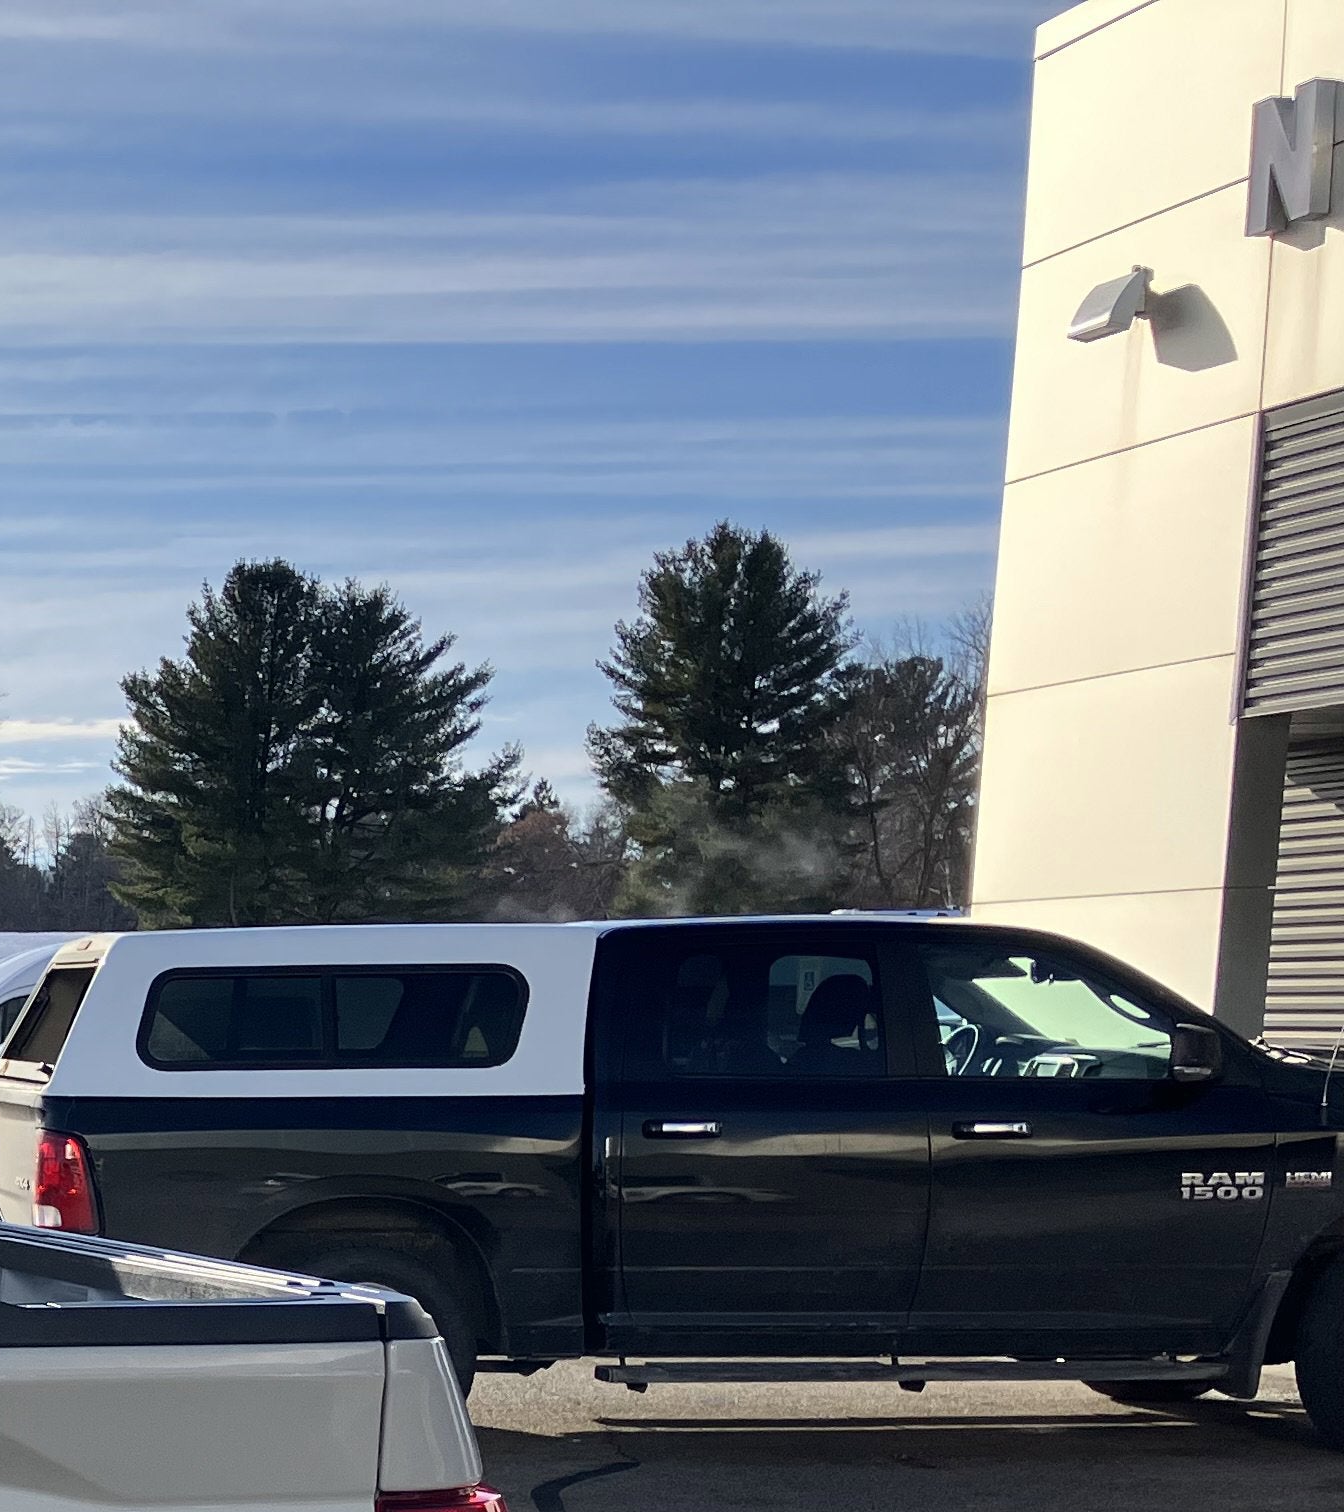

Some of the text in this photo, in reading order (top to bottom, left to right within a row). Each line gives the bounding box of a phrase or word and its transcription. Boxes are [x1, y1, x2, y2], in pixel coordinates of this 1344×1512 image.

[1181, 1172, 1265, 1186] RAM
[1286, 1171, 1332, 1182] HEMI
[1181, 1186, 1264, 1200] 1500
